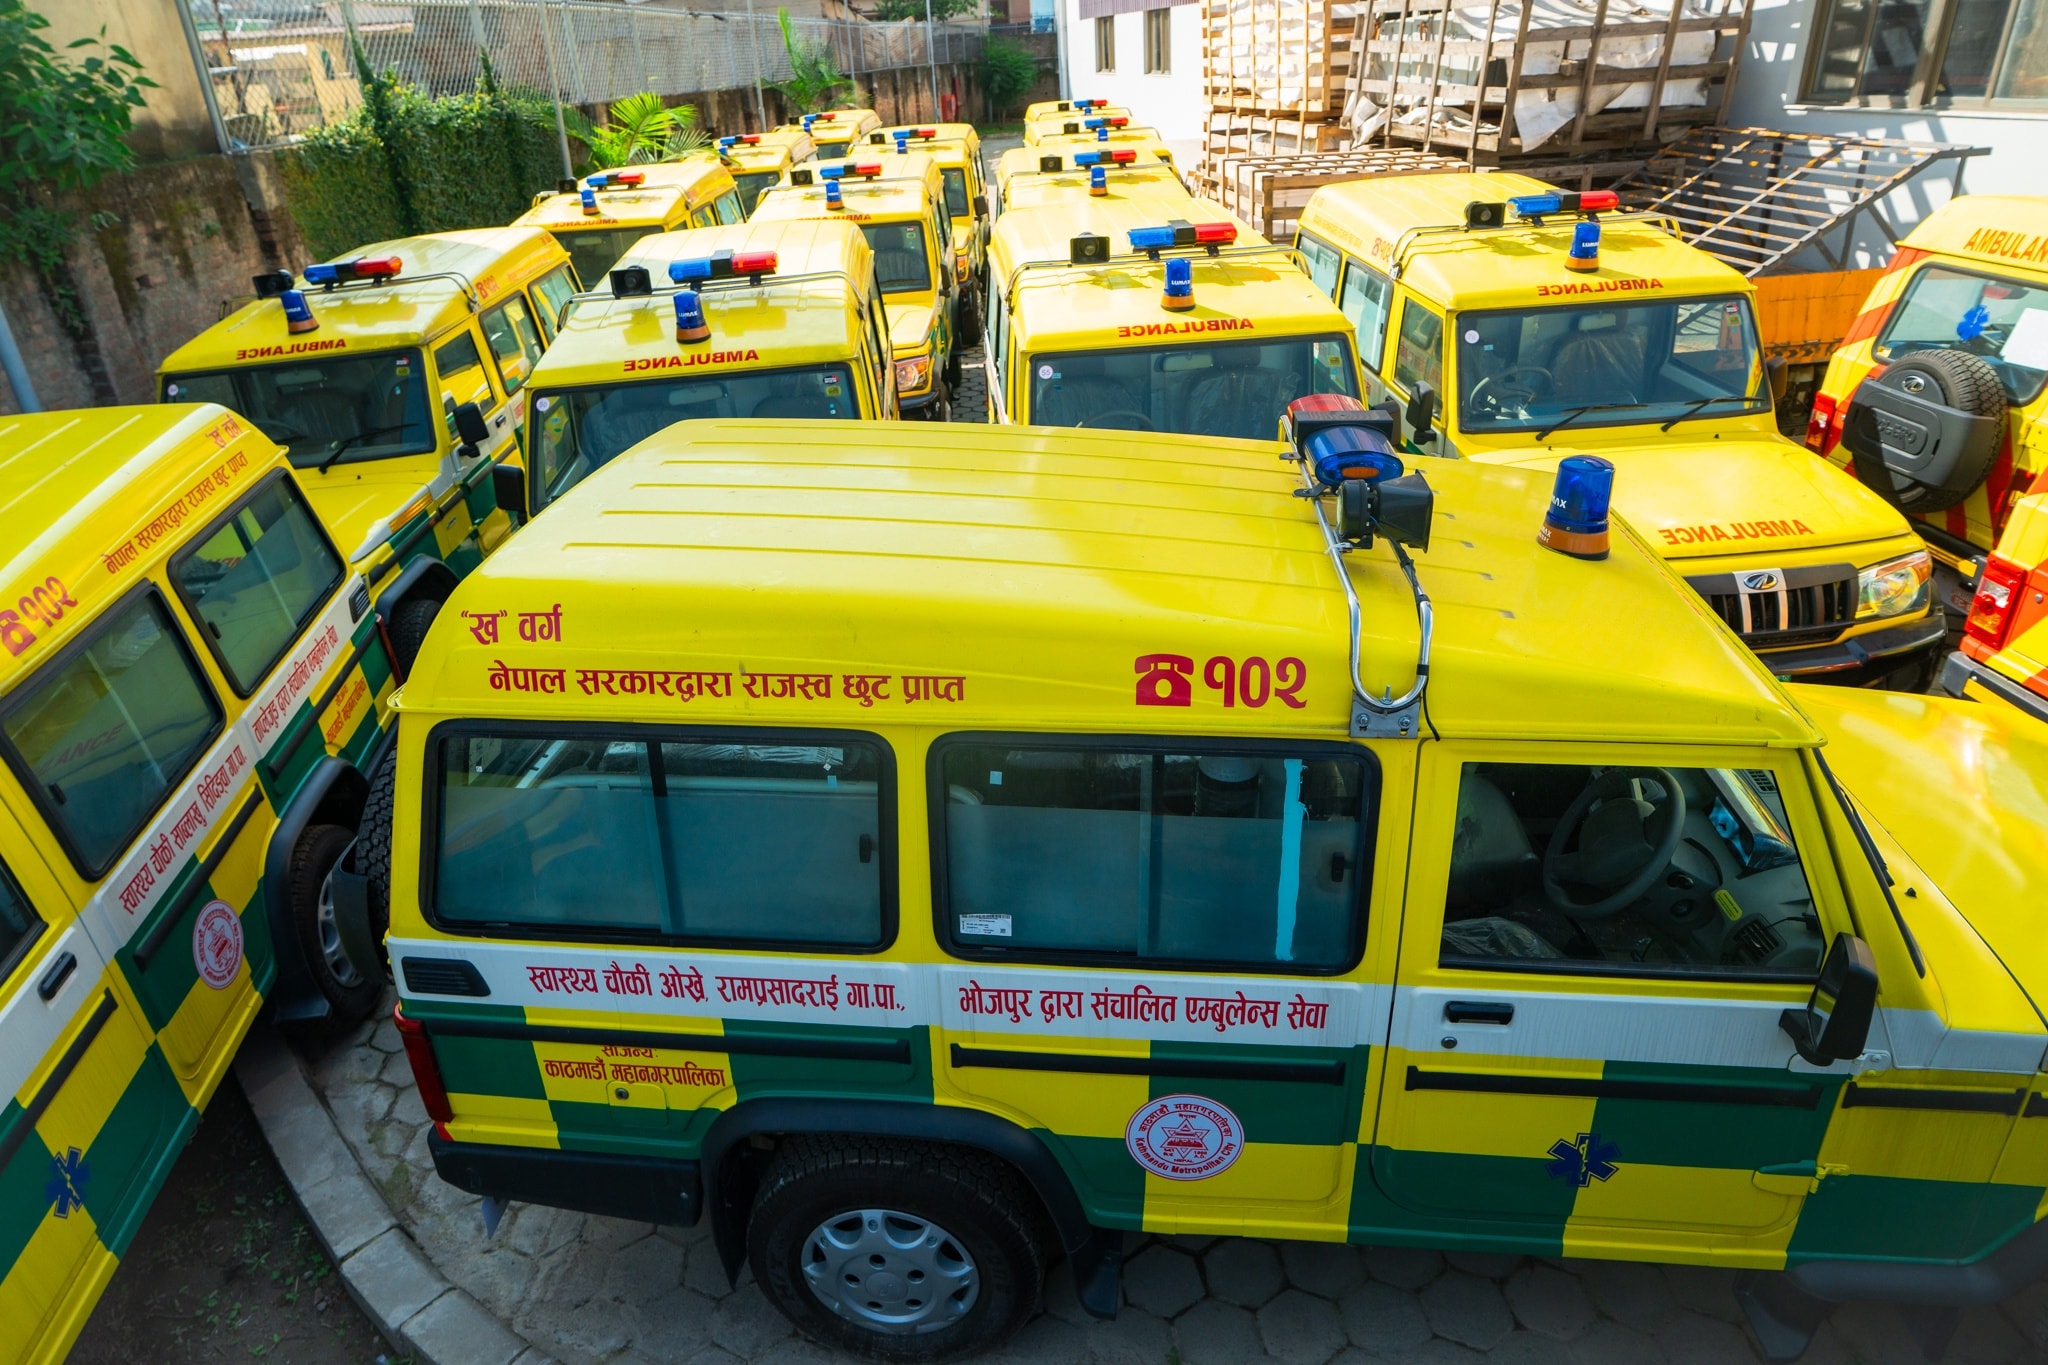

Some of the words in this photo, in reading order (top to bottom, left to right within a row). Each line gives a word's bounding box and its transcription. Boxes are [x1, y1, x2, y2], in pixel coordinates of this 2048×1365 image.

[102, 540, 139, 575] नेपाल
[134, 498, 190, 552] सरकारद्वारा
[185, 477, 216, 509] राजस्व
[213, 463, 231, 488] छुट
[18, 575, 78, 628] १०२
[518, 603, 562, 643] वर्ग
[488, 659, 566, 695] नेपाल
[576, 669, 732, 703] सरकारद्वारा
[740, 671, 832, 700] राजस्व
[843, 674, 891, 708] छुट
[902, 675, 966, 704] प्राप्त
[1203, 655, 1308, 711] १०२
[149, 832, 176, 875] चौकी
[526, 966, 599, 994] स्वास्थ्य
[602, 961, 653, 996] चौकी
[715, 974, 838, 1011] रामप्रसादराई
[958, 980, 1033, 1024] भोजपुर
[1039, 990, 1083, 1024] द्वारा
[1091, 984, 1177, 1023] संचालित
[1185, 991, 1280, 1032] एम्बुलेन्स
[1287, 993, 1329, 1029] सेवा
[609, 1060, 726, 1087] महानगरपालिका
[1135, 1137, 1169, 1171] Kathmandu
[1170, 1155, 1226, 1175] Metropolitan
[1220, 1142, 1236, 1157] City
